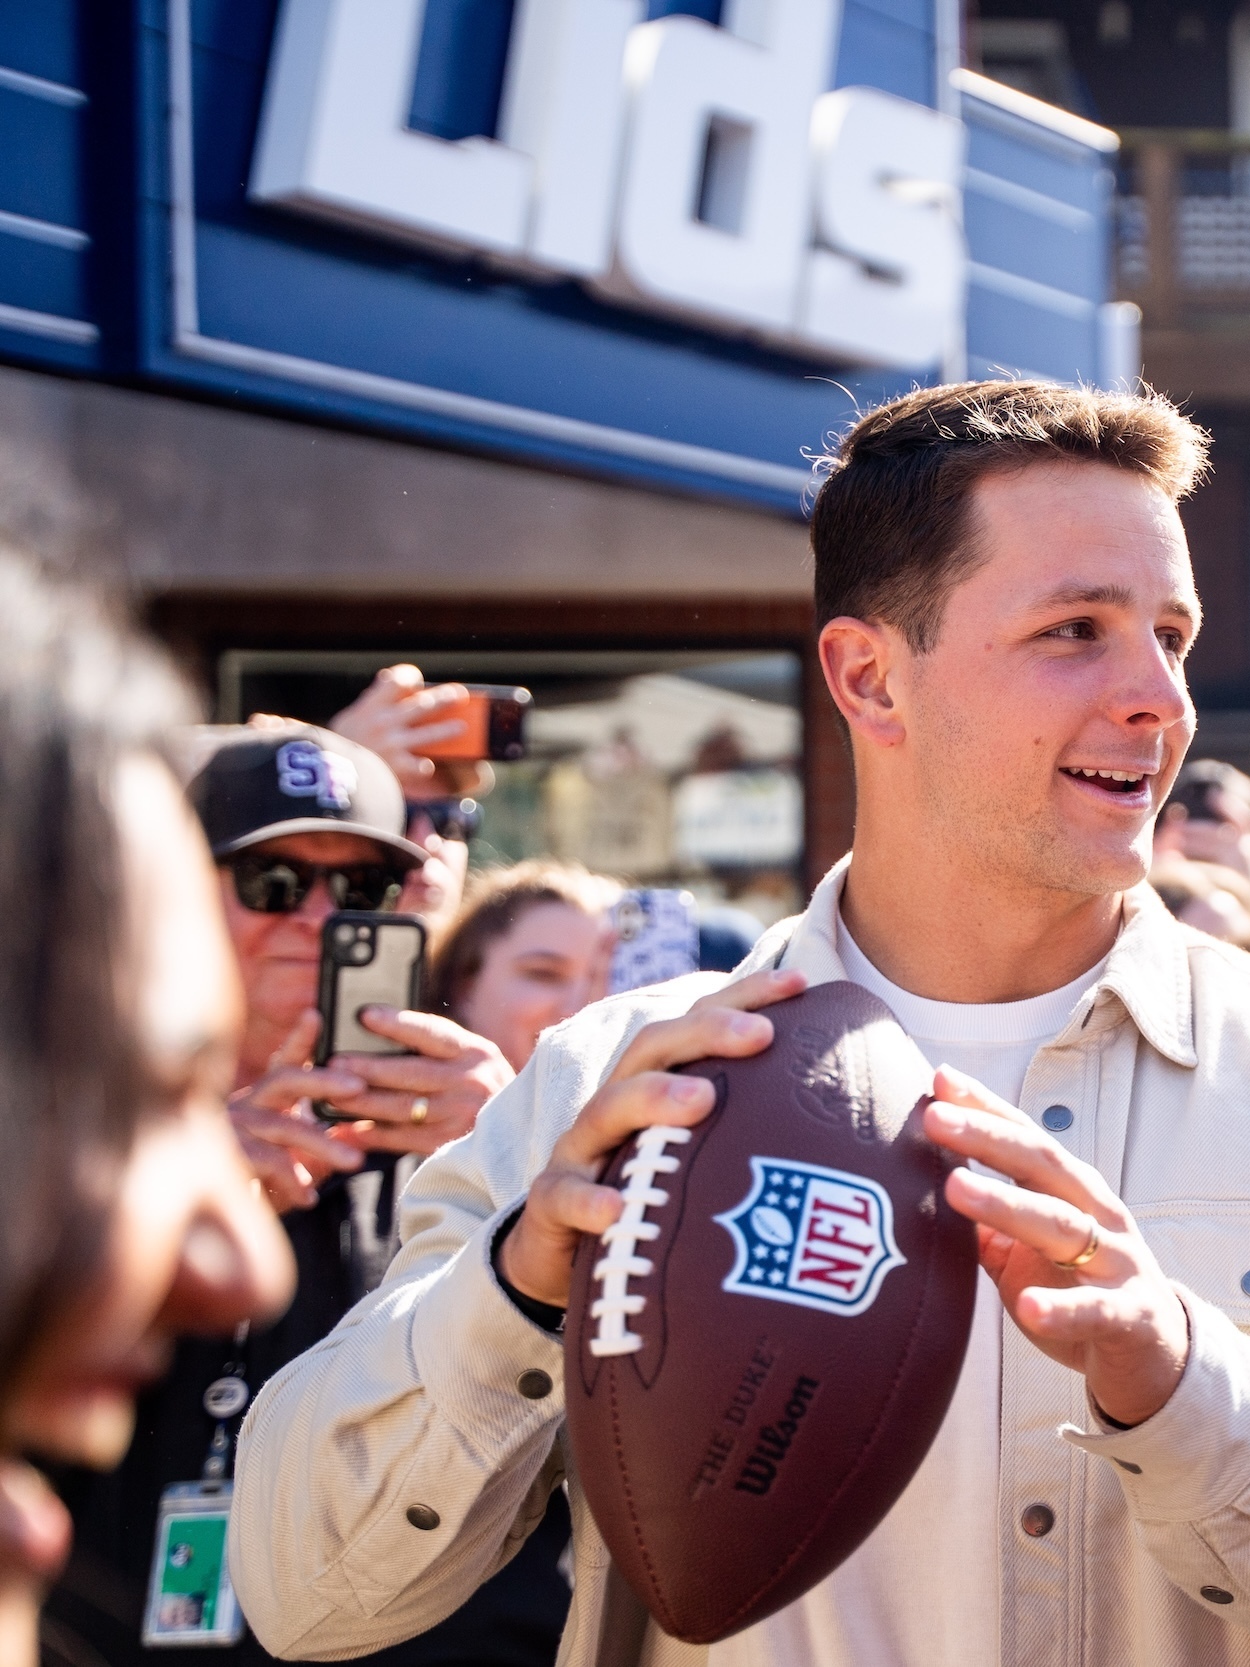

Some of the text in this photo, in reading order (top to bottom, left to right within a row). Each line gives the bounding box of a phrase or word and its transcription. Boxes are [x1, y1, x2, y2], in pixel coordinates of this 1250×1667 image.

[250, 0, 966, 370] Lids
[797, 1195, 875, 1293] NFL
[734, 1375, 820, 1496] Wilson
